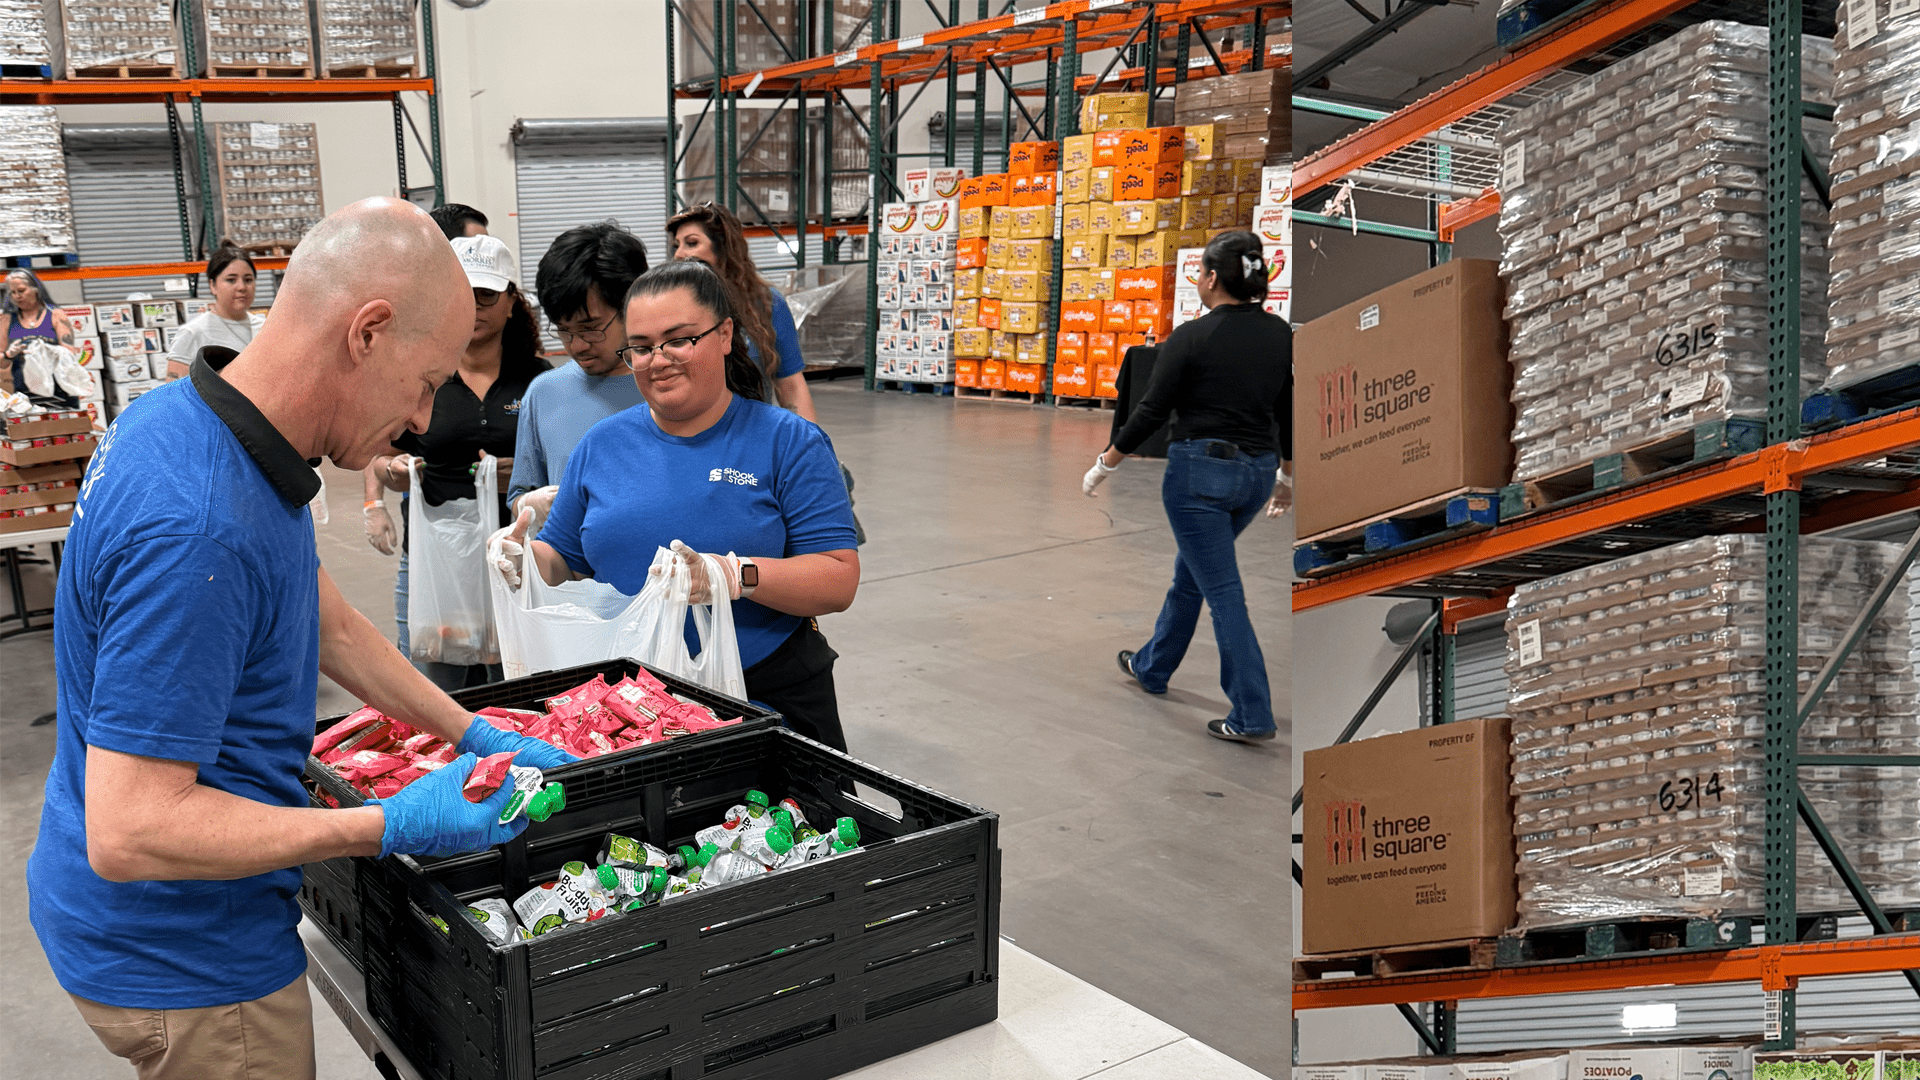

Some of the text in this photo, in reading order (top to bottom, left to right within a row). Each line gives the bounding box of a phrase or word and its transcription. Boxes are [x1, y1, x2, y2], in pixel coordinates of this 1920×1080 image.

[1126, 142, 1148, 159] peelz
[1122, 178, 1144, 194] peelz
[1656, 323, 1717, 366] 6315
[1363, 369, 1416, 402] three
[1364, 386, 1431, 423] square
[1352, 440, 1362, 450] we
[1364, 434, 1378, 445] can
[1379, 426, 1396, 440] feed
[1396, 416, 1432, 434] everyone
[1402, 450, 1430, 465] AMERICA
[724, 468, 754, 479] SHOOK
[728, 476, 758, 486] STONE
[1429, 733, 1474, 748] PROPERTY OF
[1659, 772, 1726, 812] 6314
[1372, 816, 1430, 838] three
[1373, 834, 1446, 861] square
[1327, 863, 1446, 886] together, we can feed everyone
[562, 874, 590, 910] Buddy
[1416, 889, 1446, 898] FEEDING
[1416, 896, 1446, 906] AMERICA
[1584, 1066, 1632, 1076] POTATOES
[1704, 1060, 1734, 1068] POTATOES
